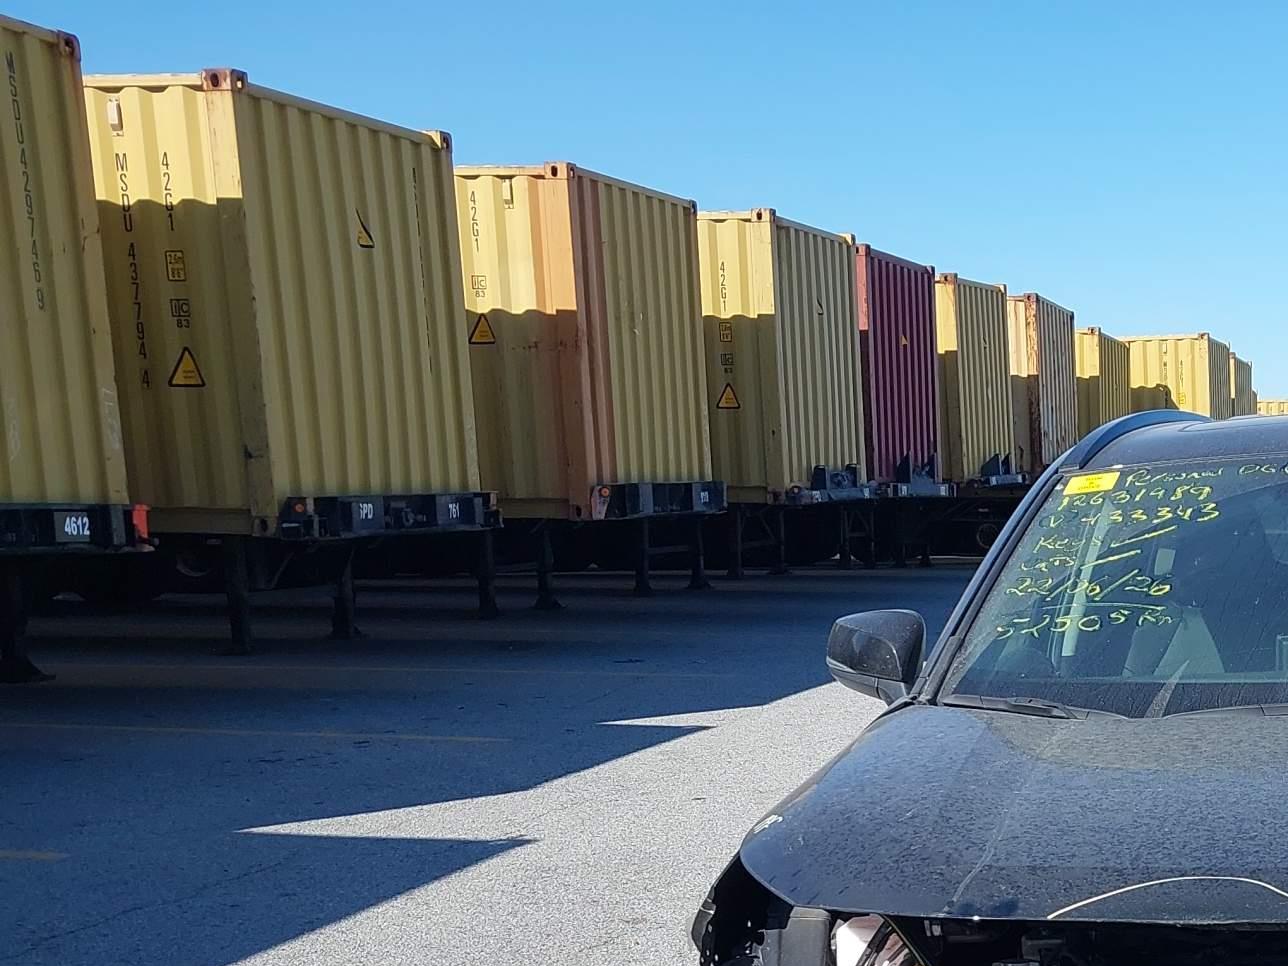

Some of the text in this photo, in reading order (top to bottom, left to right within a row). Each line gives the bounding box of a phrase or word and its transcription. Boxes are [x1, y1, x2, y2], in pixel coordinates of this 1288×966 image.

[161, 151, 175, 231] 42G1
[470, 190, 480, 252] 42G1
[115, 152, 133, 232] MSDU
[128, 242, 147, 359] 437794
[719, 261, 728, 312] 42G1
[176, 319, 190, 329] 83
[1057, 482, 1213, 512] 12631489
[64, 516, 91, 535] 4612
